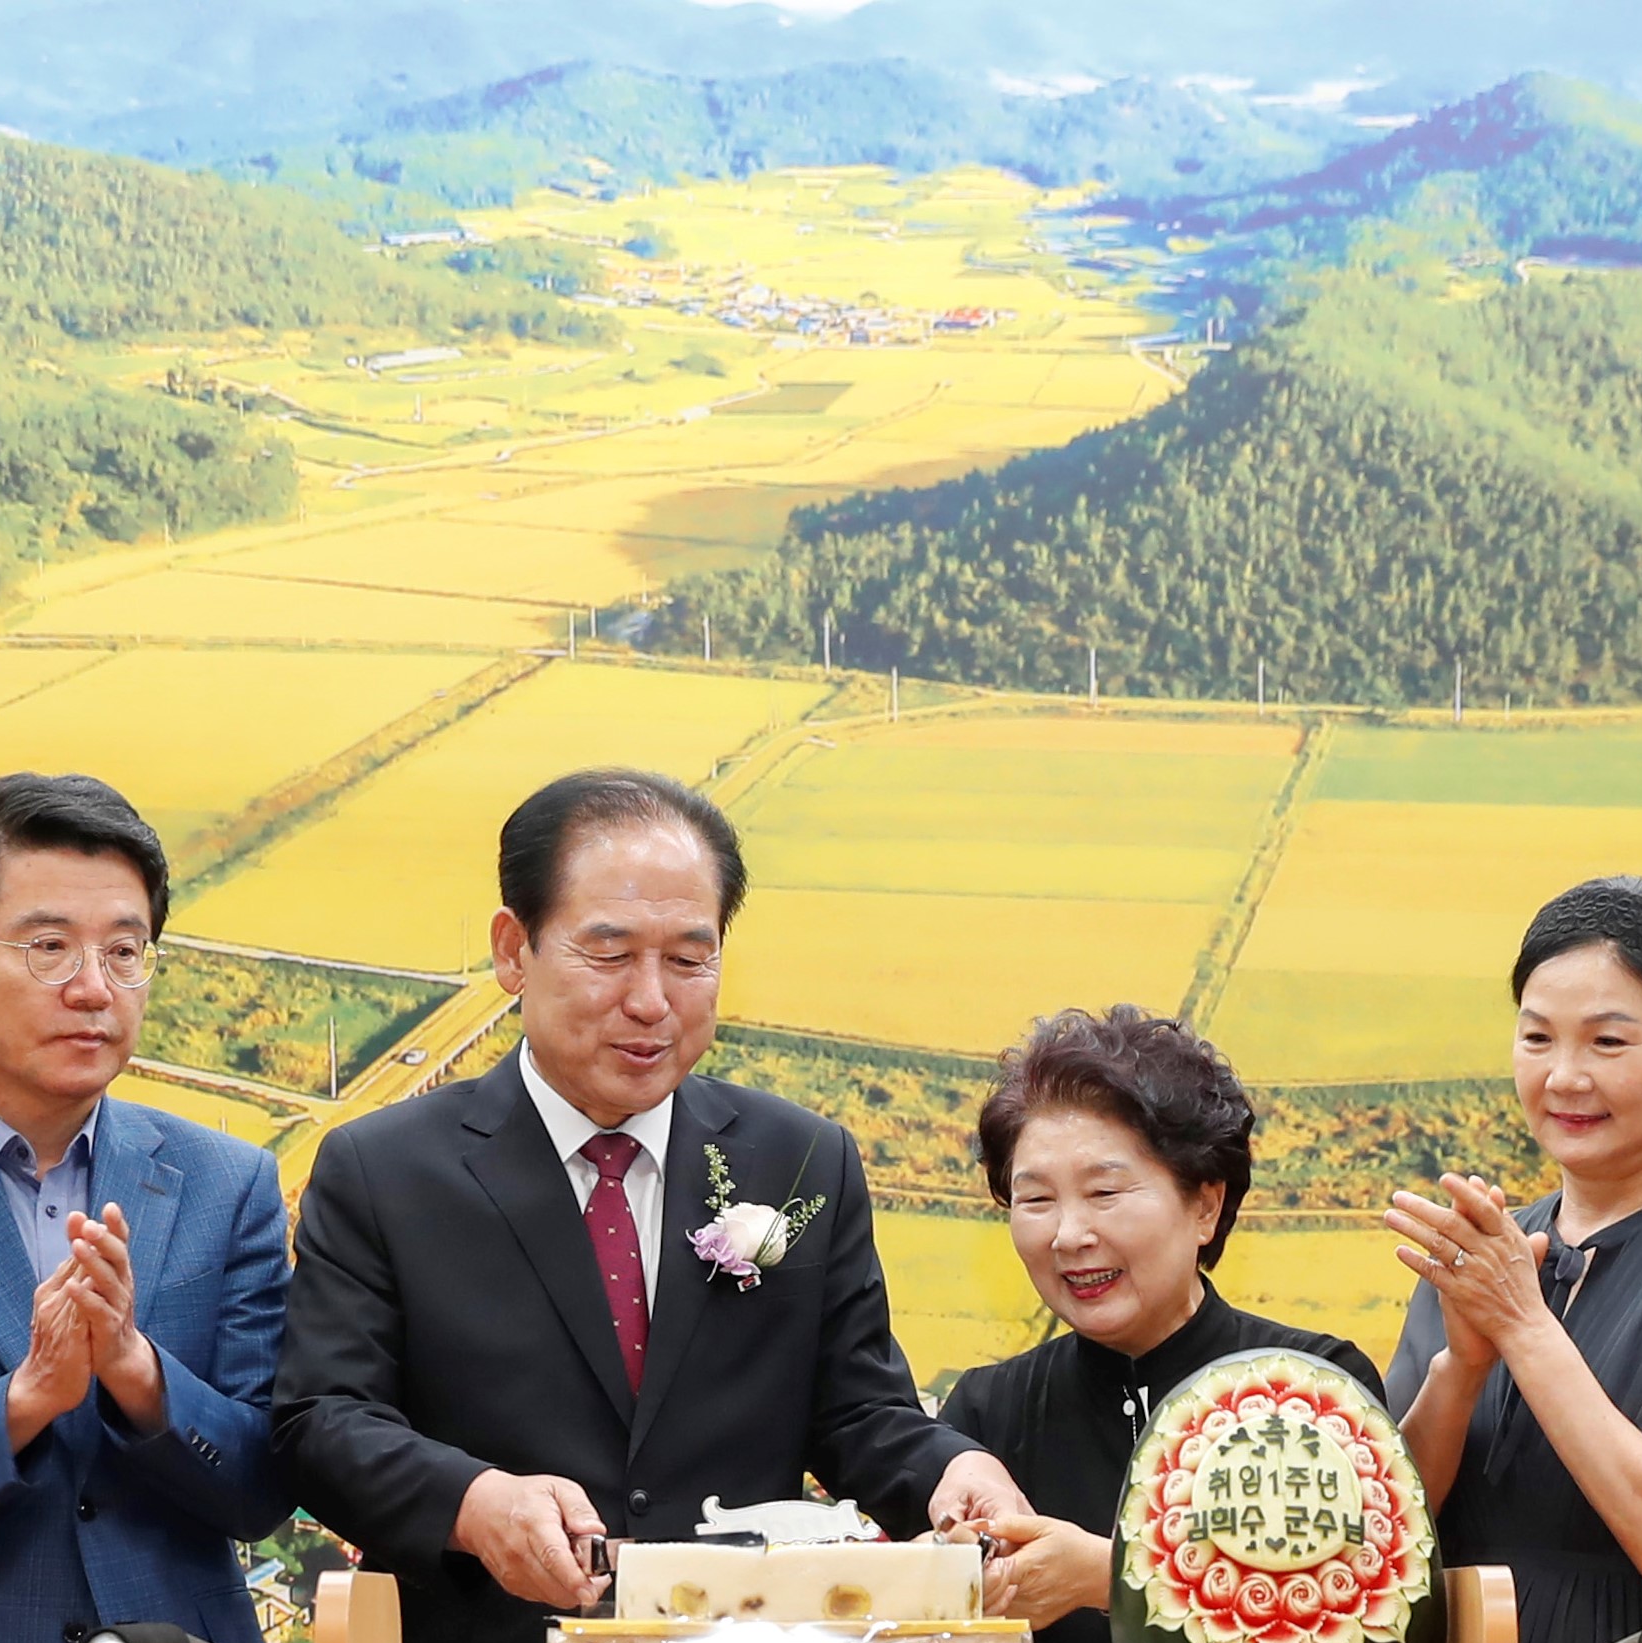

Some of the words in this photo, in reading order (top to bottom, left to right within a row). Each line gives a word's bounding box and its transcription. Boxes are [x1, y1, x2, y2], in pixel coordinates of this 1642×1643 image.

[1257, 1415, 1290, 1451] 축
[1185, 1506, 1266, 1543] 김희수
[1283, 1506, 1366, 1545] 군수님
